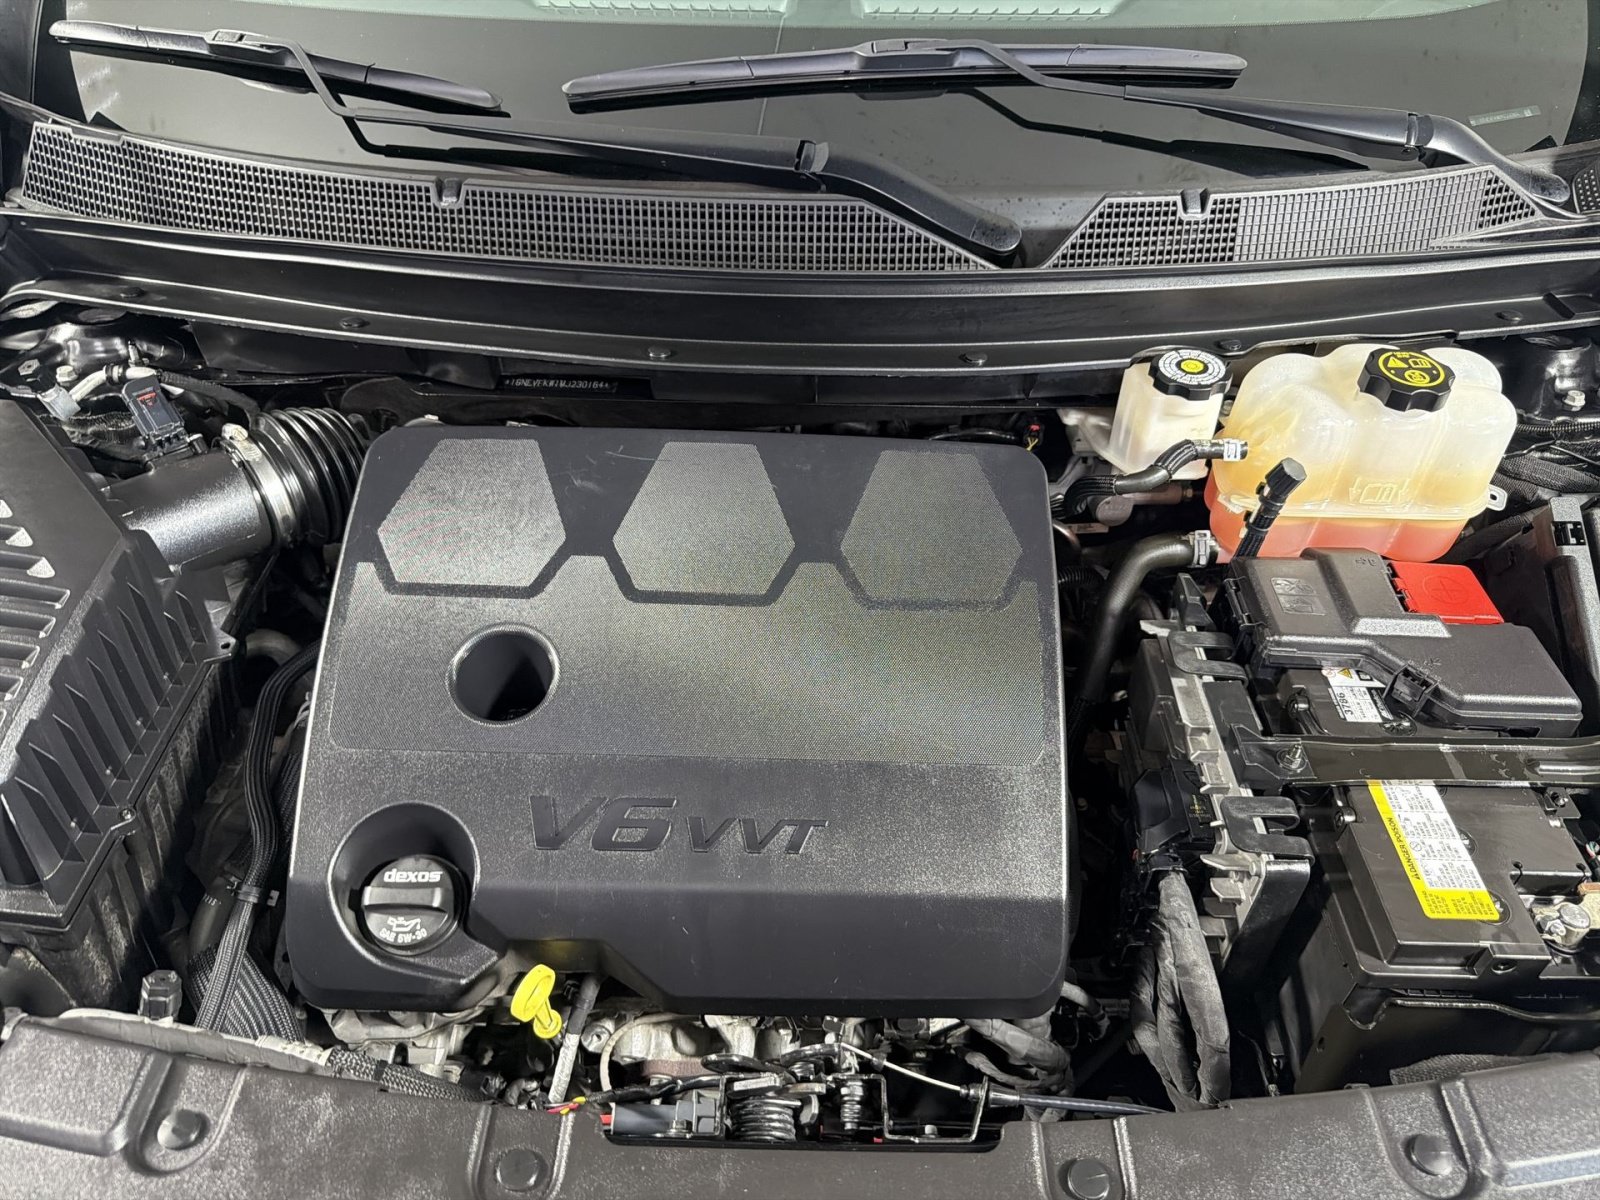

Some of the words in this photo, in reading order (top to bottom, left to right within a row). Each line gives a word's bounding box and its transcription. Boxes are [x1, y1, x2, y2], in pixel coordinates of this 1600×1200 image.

[1337, 692, 1354, 716] 3786
[529, 796, 677, 851] V6
[686, 816, 829, 854] VVT
[1387, 817, 1404, 843] POISON
[1399, 844, 1417, 874] DANGER
[383, 868, 443, 883] dexos
[380, 927, 397, 942] SAE
